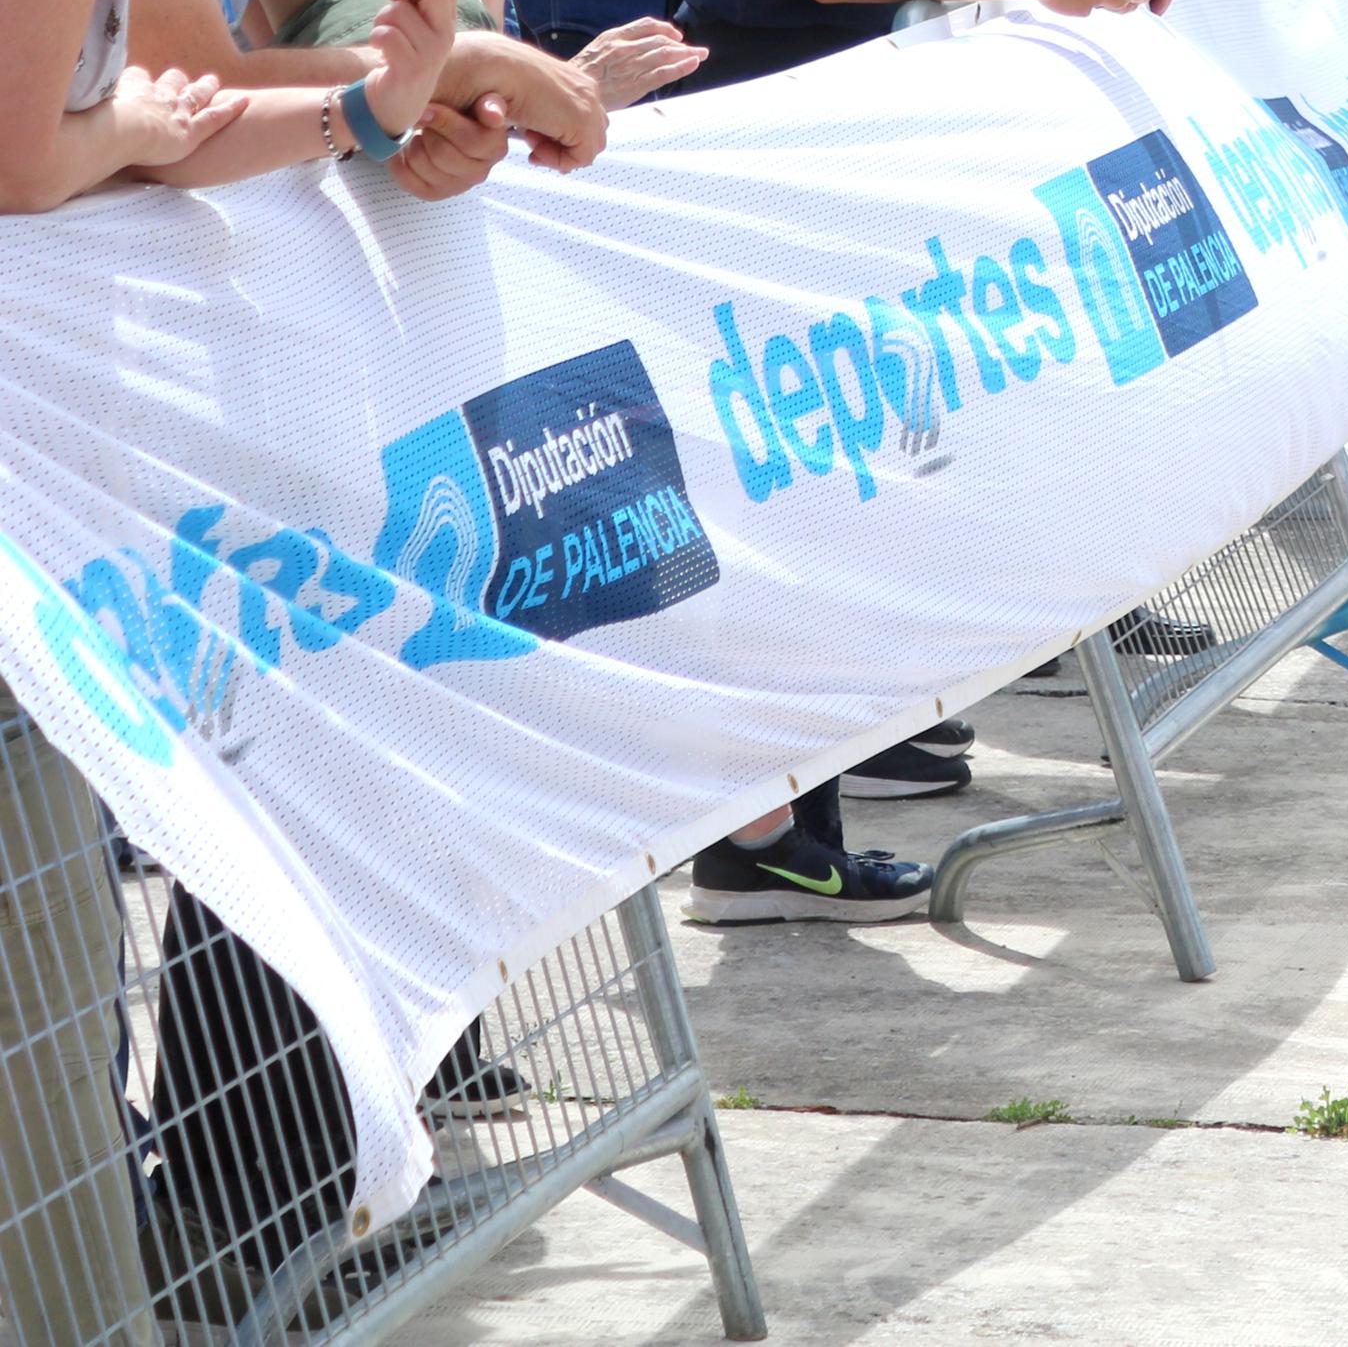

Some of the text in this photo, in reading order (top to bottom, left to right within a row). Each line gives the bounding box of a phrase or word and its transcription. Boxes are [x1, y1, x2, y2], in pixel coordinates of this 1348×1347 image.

[1107, 168, 1194, 245] Diputación
[1143, 230, 1242, 318] DE PALENCIA
[708, 235, 1076, 504] deportes
[487, 402, 633, 519] Diputación
[495, 485, 702, 619] DE PALENCIA
